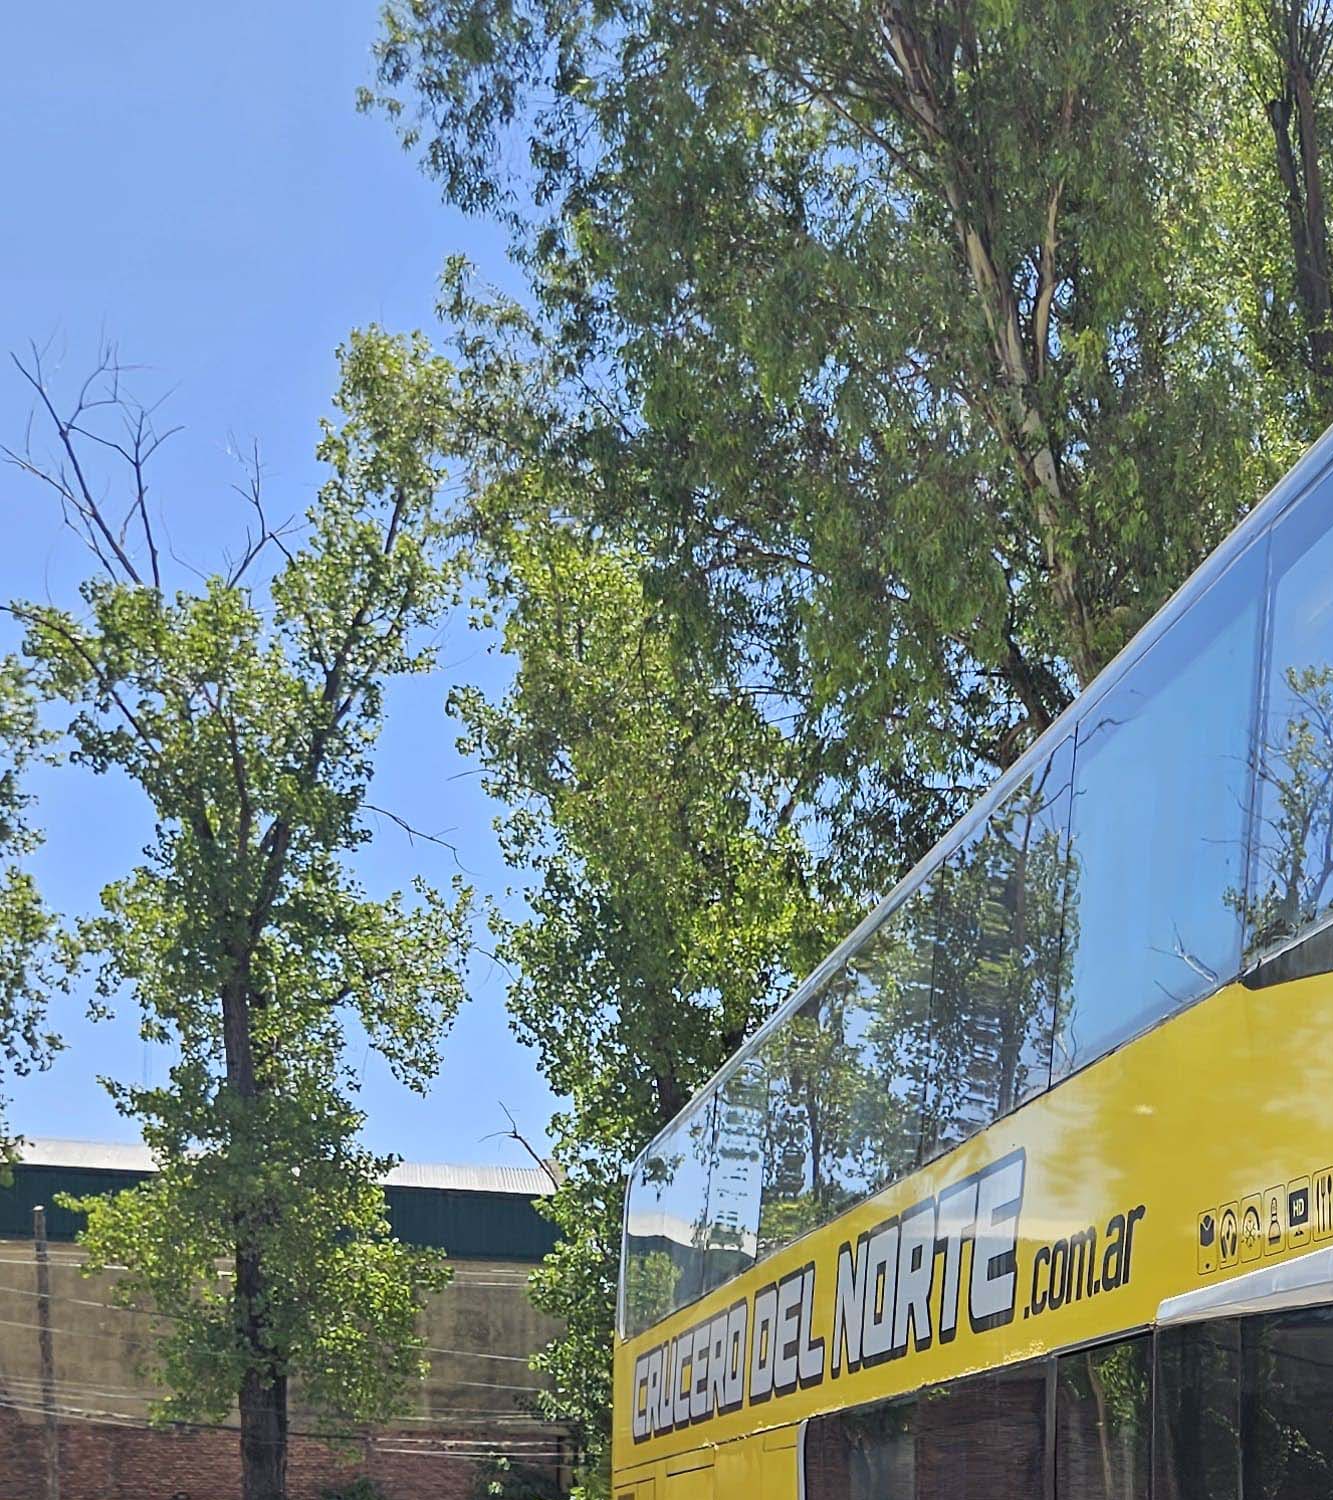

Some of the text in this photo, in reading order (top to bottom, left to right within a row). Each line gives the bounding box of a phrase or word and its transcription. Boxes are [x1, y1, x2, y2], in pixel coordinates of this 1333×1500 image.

[1292, 1197, 1305, 1218] HD
[632, 1147, 1146, 1444] CRUCERO DEL NORTE .com.ar
